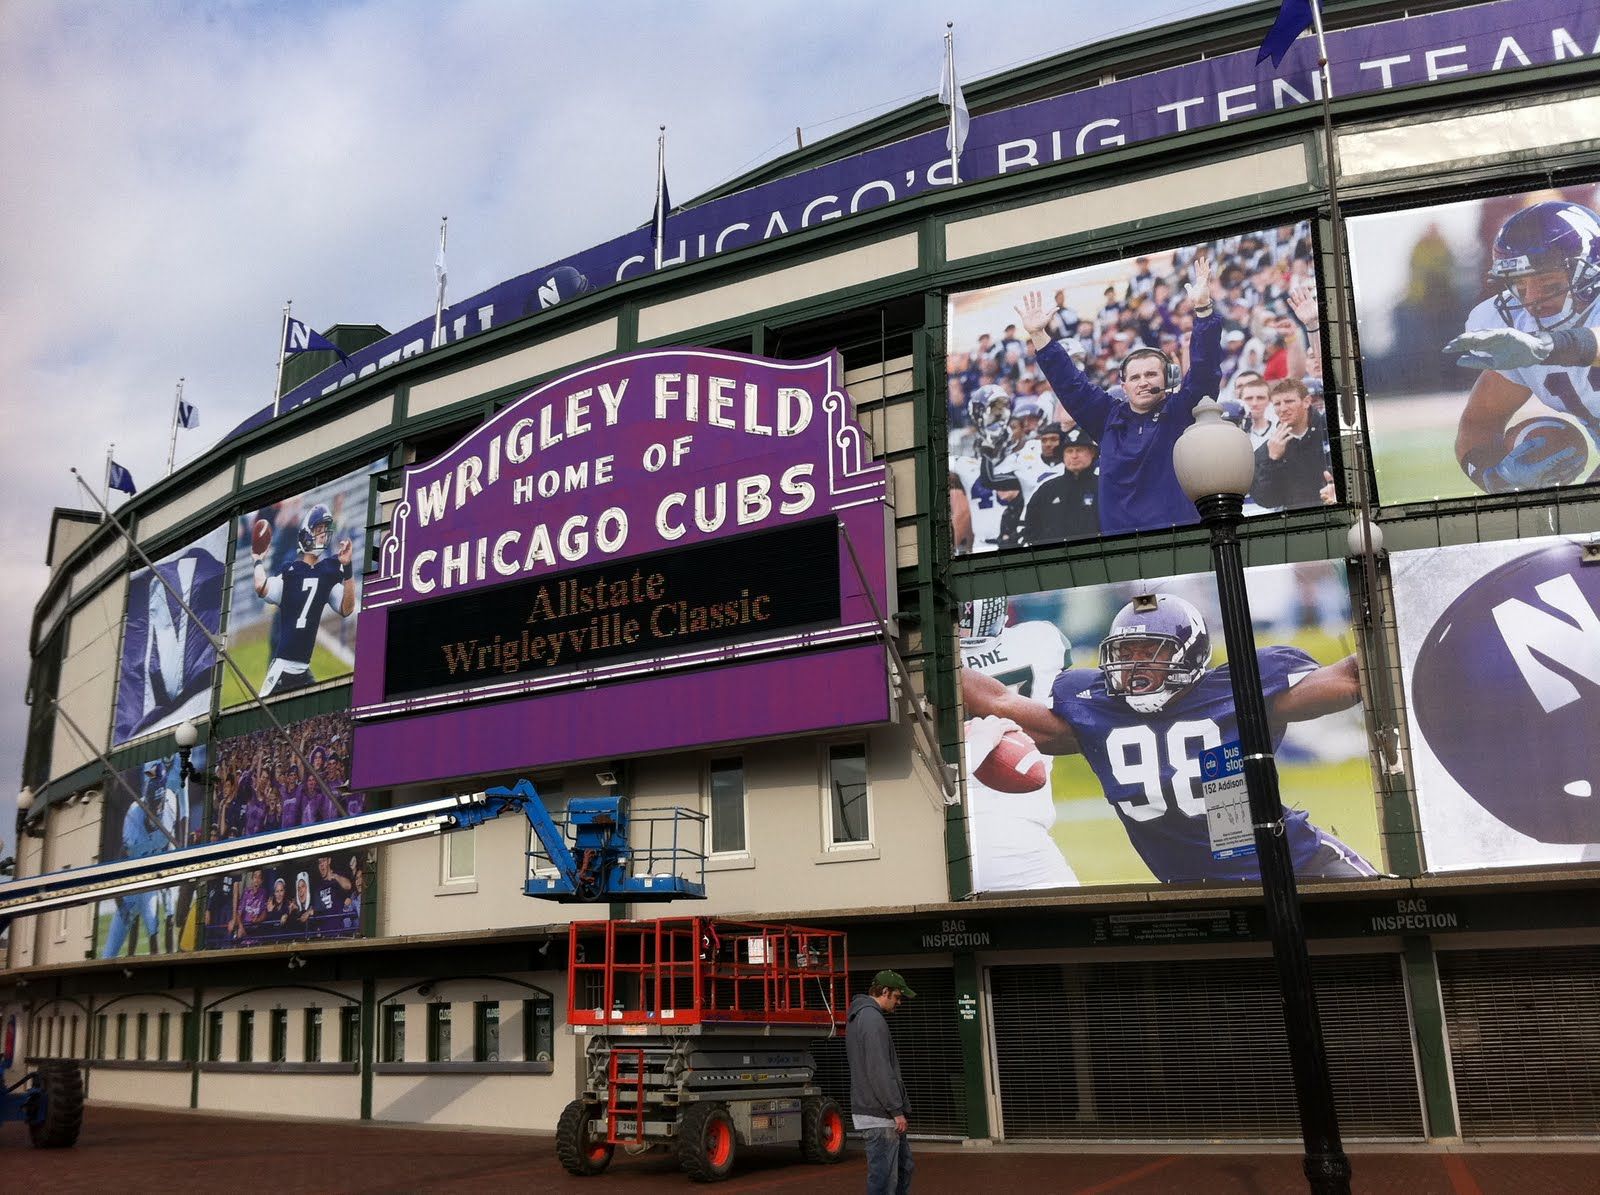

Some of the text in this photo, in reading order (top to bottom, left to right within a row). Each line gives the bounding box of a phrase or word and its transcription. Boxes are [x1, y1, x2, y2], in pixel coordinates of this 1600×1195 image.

[997, 117, 1127, 175] BIG
[1157, 69, 1321, 133] TEN
[289, 322, 311, 350] N
[416, 372, 814, 527] WRIGLEY FIELD
[513, 434, 694, 506] HOME OF
[411, 463, 816, 594] CHICAGO CUBS
[295, 577, 319, 629] 7
[526, 569, 666, 624] Allstate
[440, 588, 771, 675] Wrigleyville Classic
[1205, 759, 1217, 770] cta
[1223, 746, 1240, 760] bus
[1225, 758, 1245, 773] stop
[1105, 717, 1221, 822] 98
[1204, 778, 1244, 796] 152 Addison
[1396, 898, 1428, 914] BAG
[941, 919, 967, 933] BAG
[1371, 912, 1458, 931] INSPECTION
[922, 931, 990, 948] INSPECTION
